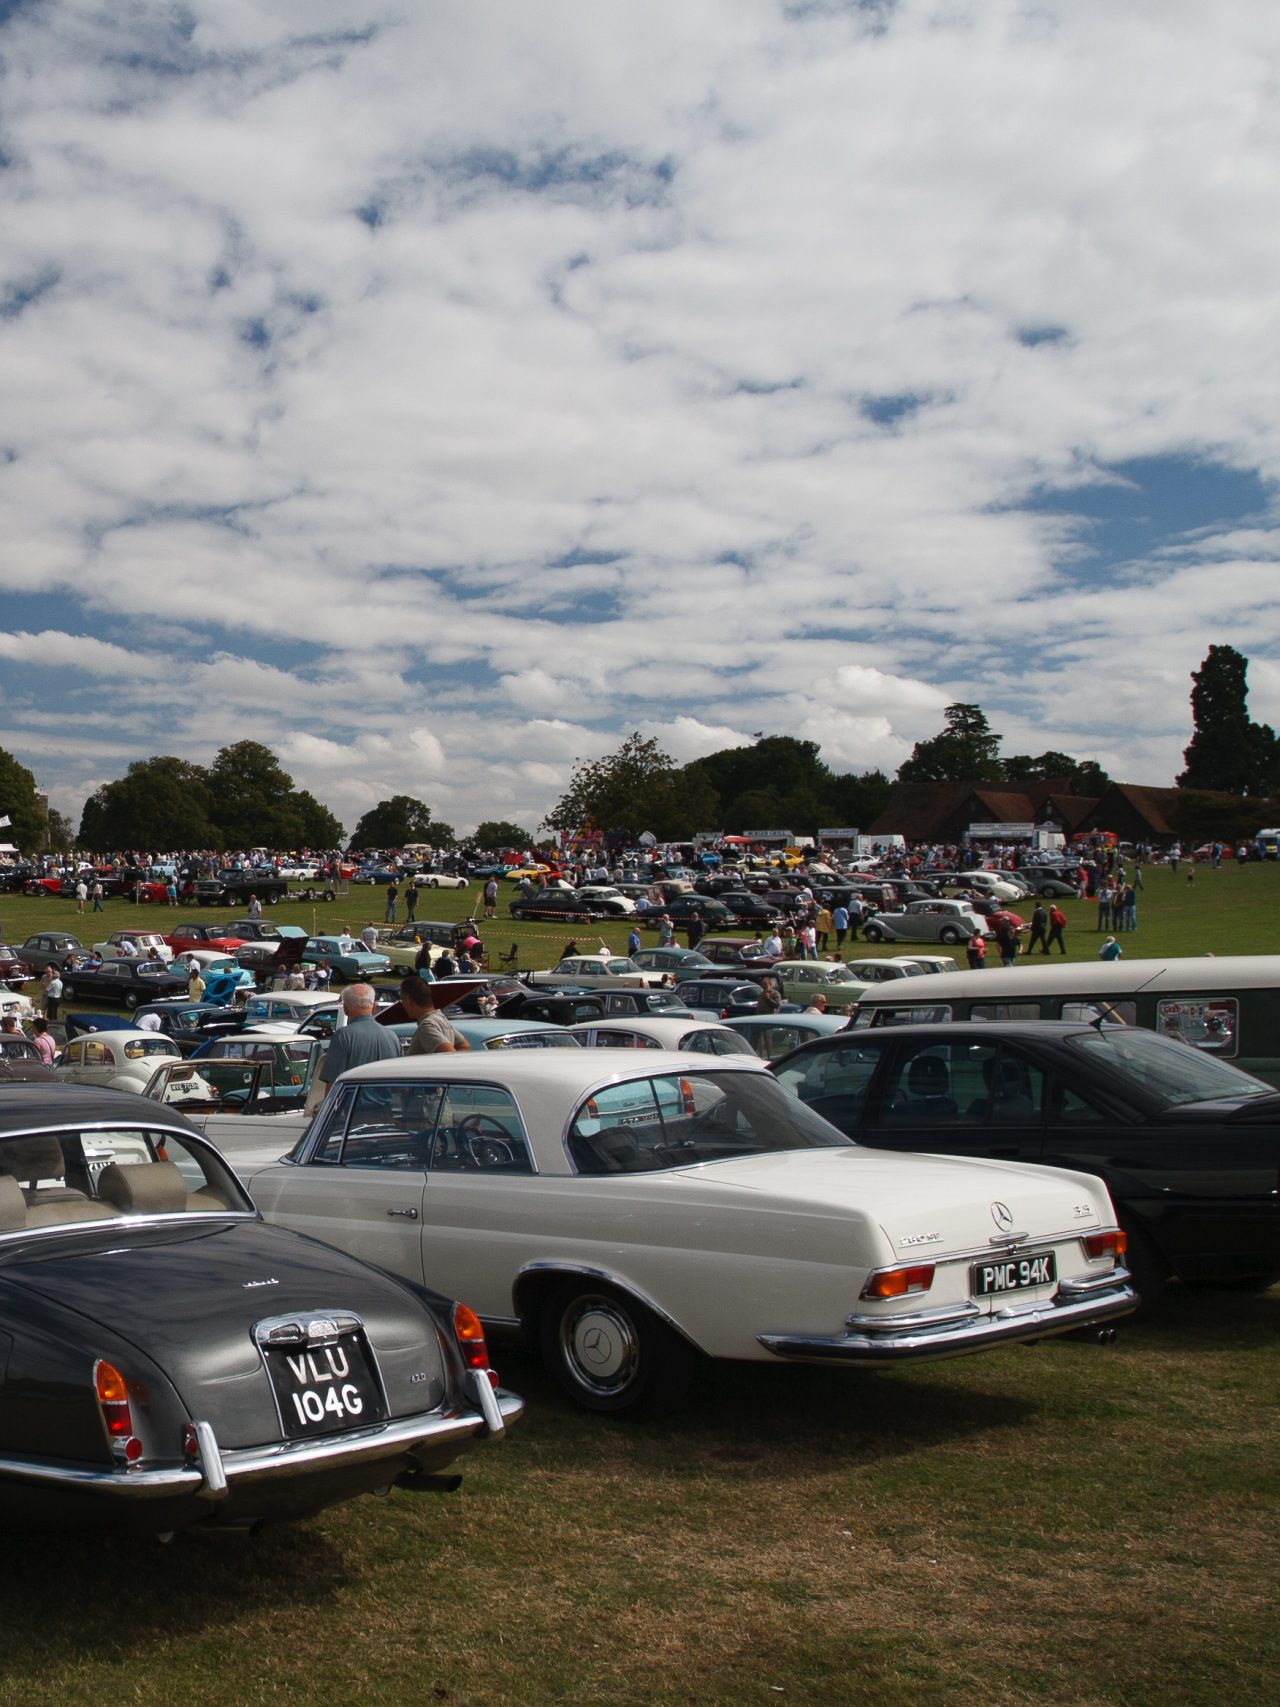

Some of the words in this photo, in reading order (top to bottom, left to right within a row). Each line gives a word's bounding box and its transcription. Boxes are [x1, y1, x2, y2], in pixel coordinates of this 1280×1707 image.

[983, 1263, 1017, 1293] PMC
[1020, 1257, 1050, 1286] 94K
[286, 1347, 350, 1385] VLU
[292, 1383, 363, 1426] 104G
